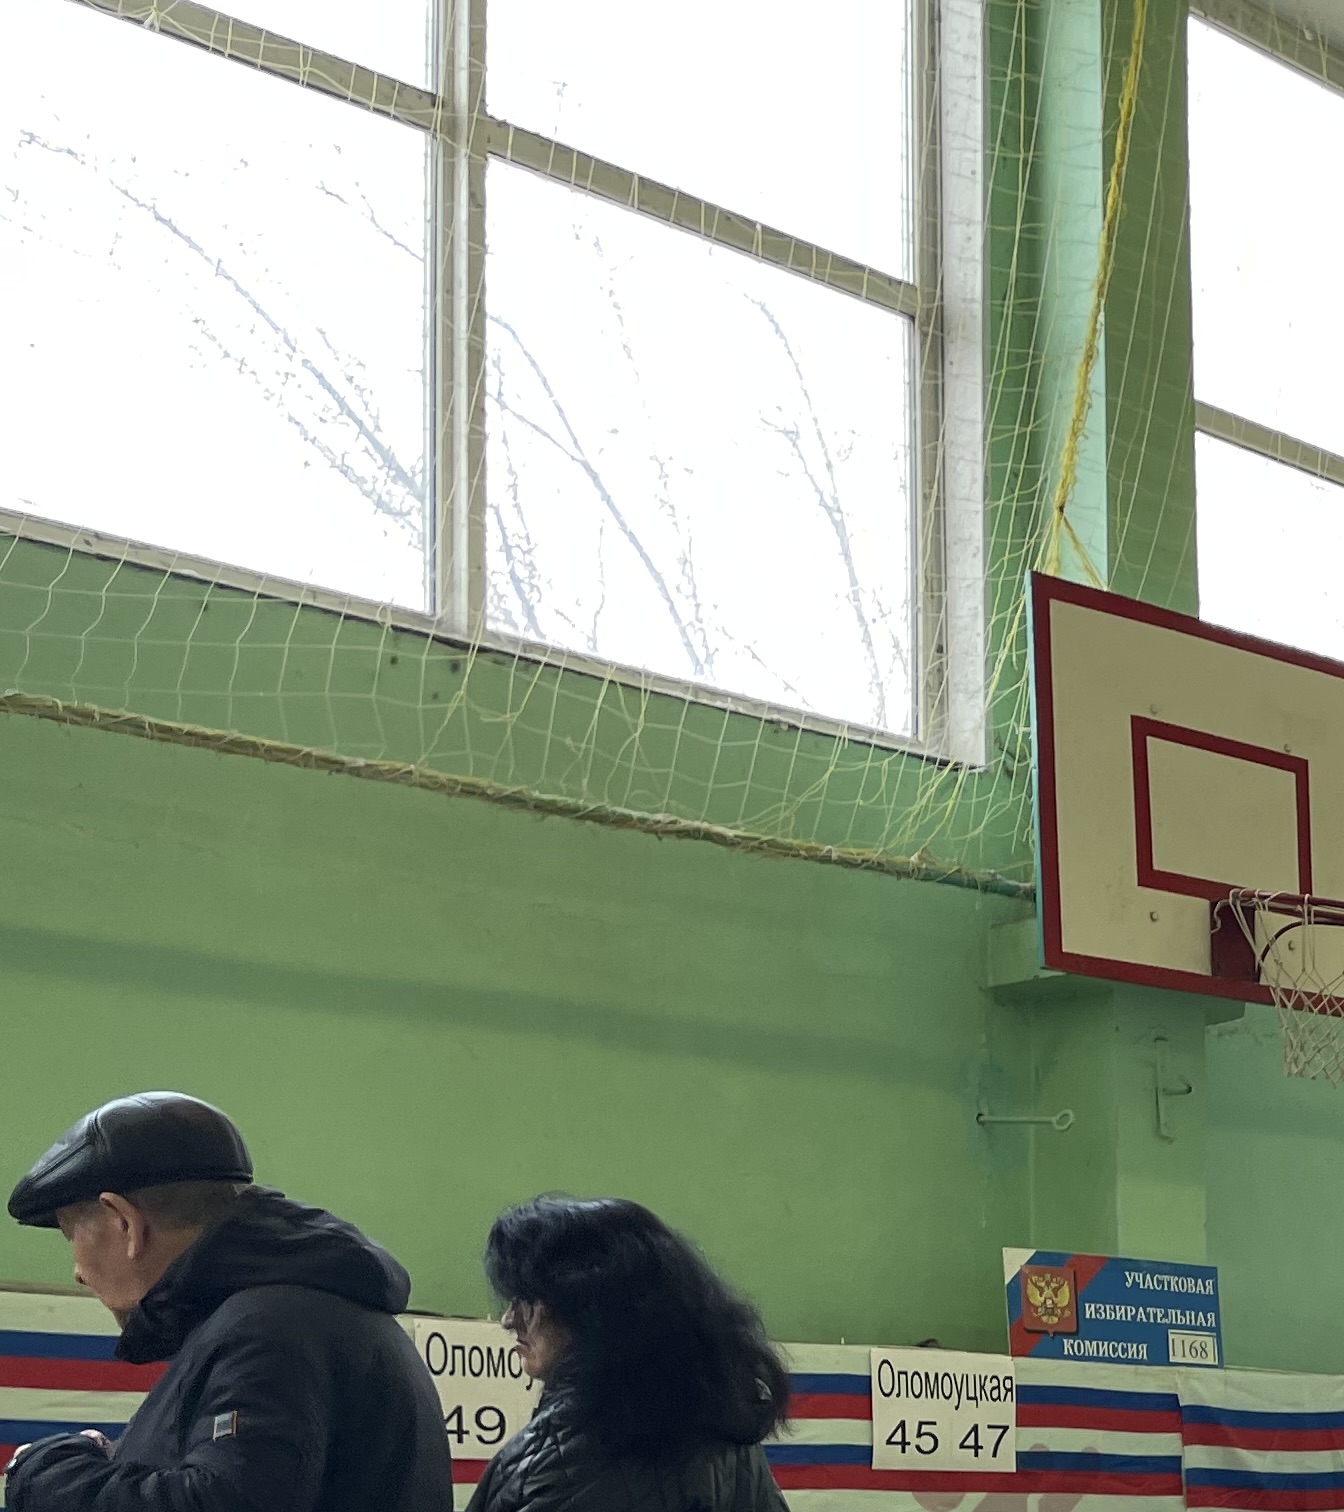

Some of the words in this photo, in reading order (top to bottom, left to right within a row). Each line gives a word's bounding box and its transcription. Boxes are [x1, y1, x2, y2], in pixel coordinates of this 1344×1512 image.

[1125, 1271, 1214, 1295] УЧАСТКОВАЯ
[1085, 1303, 1216, 1327] ИЗБИРАТЕЛЬНАЯ
[426, 1332, 533, 1391] Оломо
[1063, 1339, 1147, 1360] КОМИССИЯ
[1172, 1335, 1208, 1359] 1168
[878, 1359, 1014, 1410] Оломоуцкая
[444, 1405, 506, 1445] 49
[886, 1419, 939, 1454] 45
[959, 1423, 1009, 1458] 47
